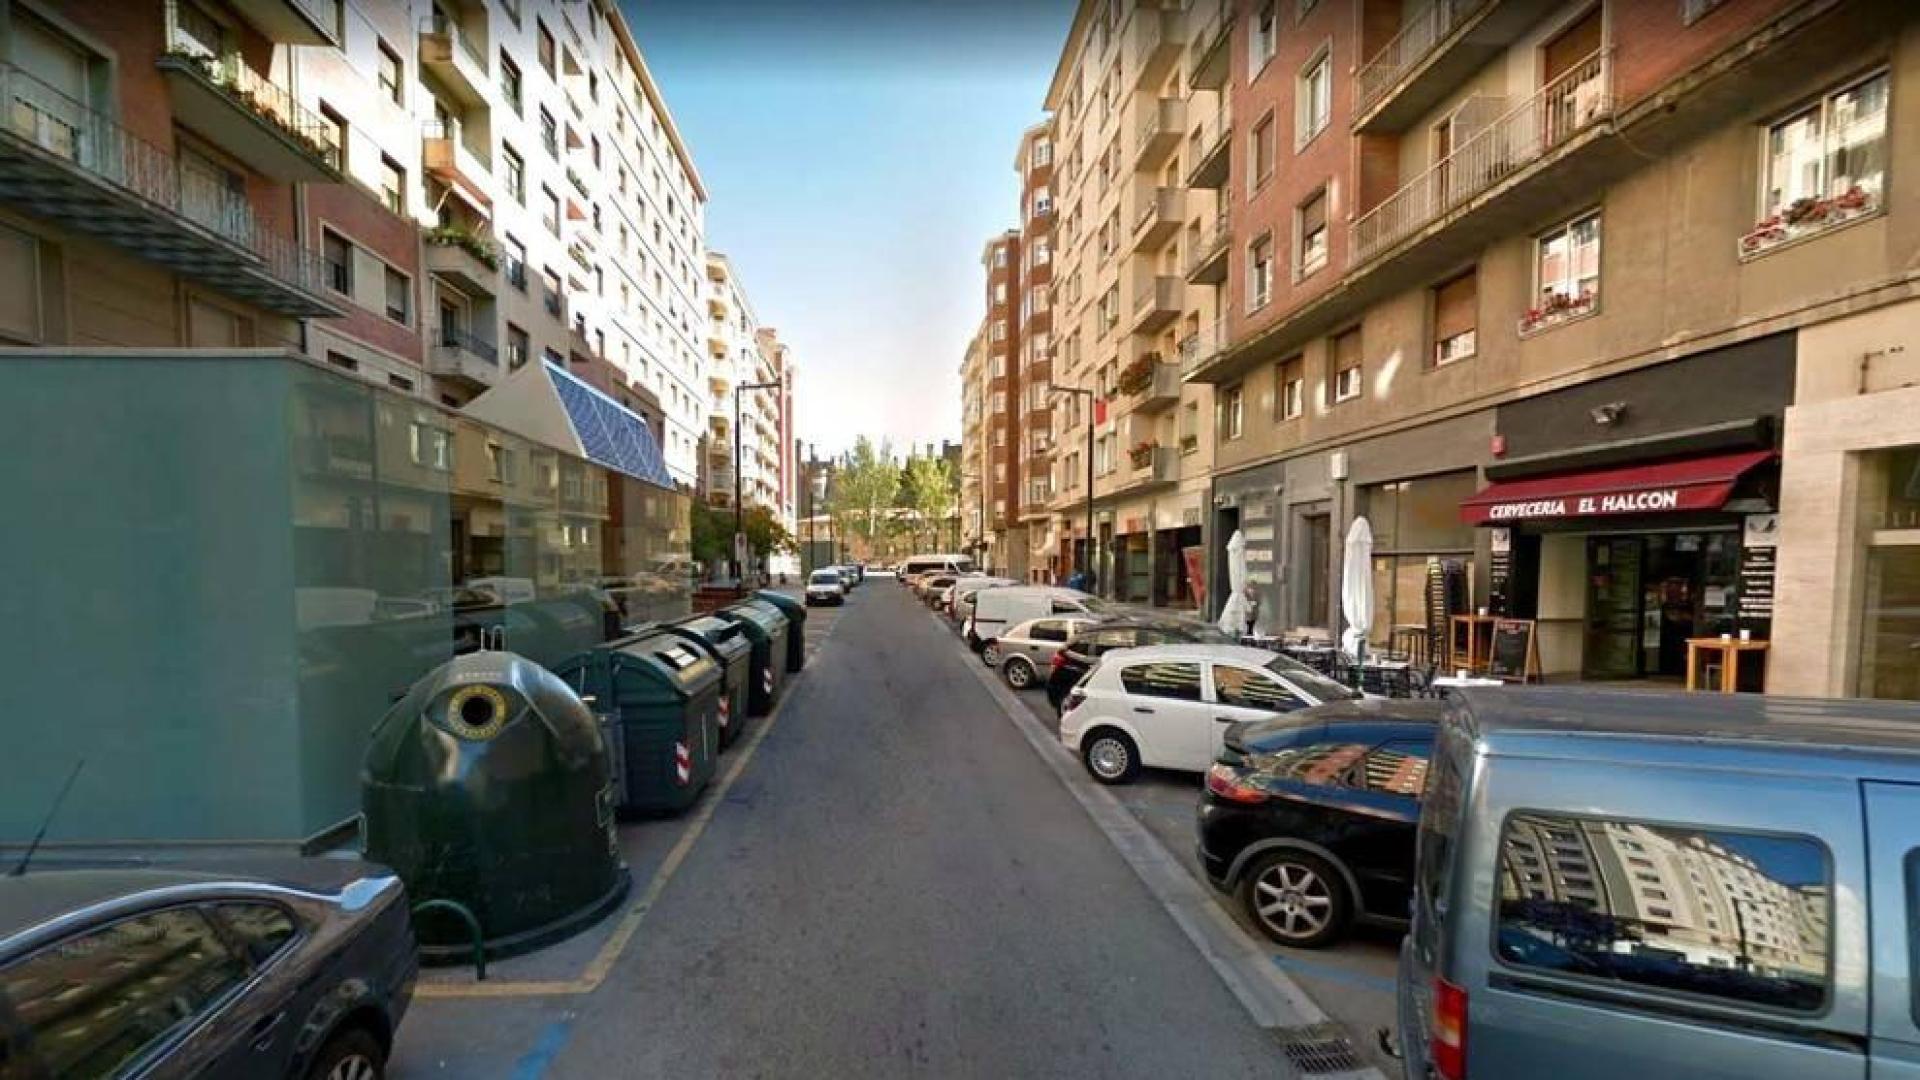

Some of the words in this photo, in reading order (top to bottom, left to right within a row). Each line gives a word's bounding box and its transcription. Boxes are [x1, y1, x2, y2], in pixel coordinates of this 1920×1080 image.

[1489, 500, 1566, 519] CERVECERIA
[1578, 497, 1597, 513] EL
[1602, 490, 1679, 511] HALCON
